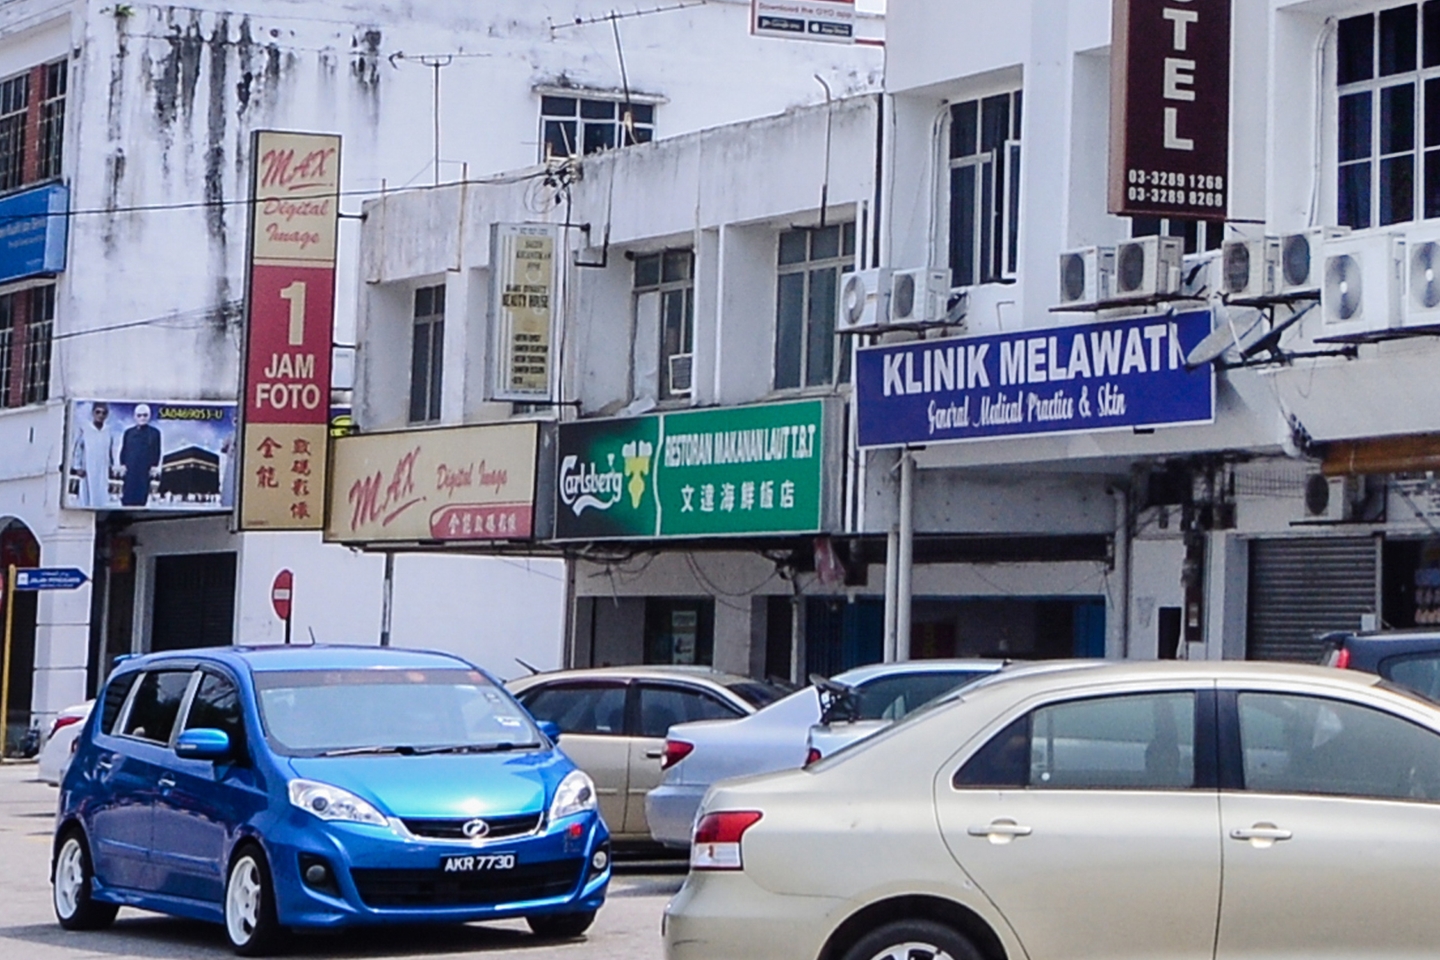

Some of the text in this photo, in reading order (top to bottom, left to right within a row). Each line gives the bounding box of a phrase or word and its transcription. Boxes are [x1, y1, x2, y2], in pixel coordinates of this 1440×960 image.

[261, 148, 336, 188] MAX
[1128, 169, 1223, 190] 03-3289 1268
[263, 197, 330, 223] Digital
[1128, 186, 1223, 207] 03-3289 8268
[265, 223, 320, 249] Image
[280, 280, 307, 346] 1
[264, 353, 314, 379] JAM
[882, 324, 1180, 397] KLINIK MELAWATI
[255, 383, 321, 410] FOTO
[928, 381, 1127, 436] General Medical Practice & Skin
[664, 433, 713, 468] RESTORAN
[349, 446, 421, 532] MAX
[436, 463, 474, 497] Digital
[560, 454, 623, 505] Carlsberg
[444, 854, 515, 872] AKR 7730
